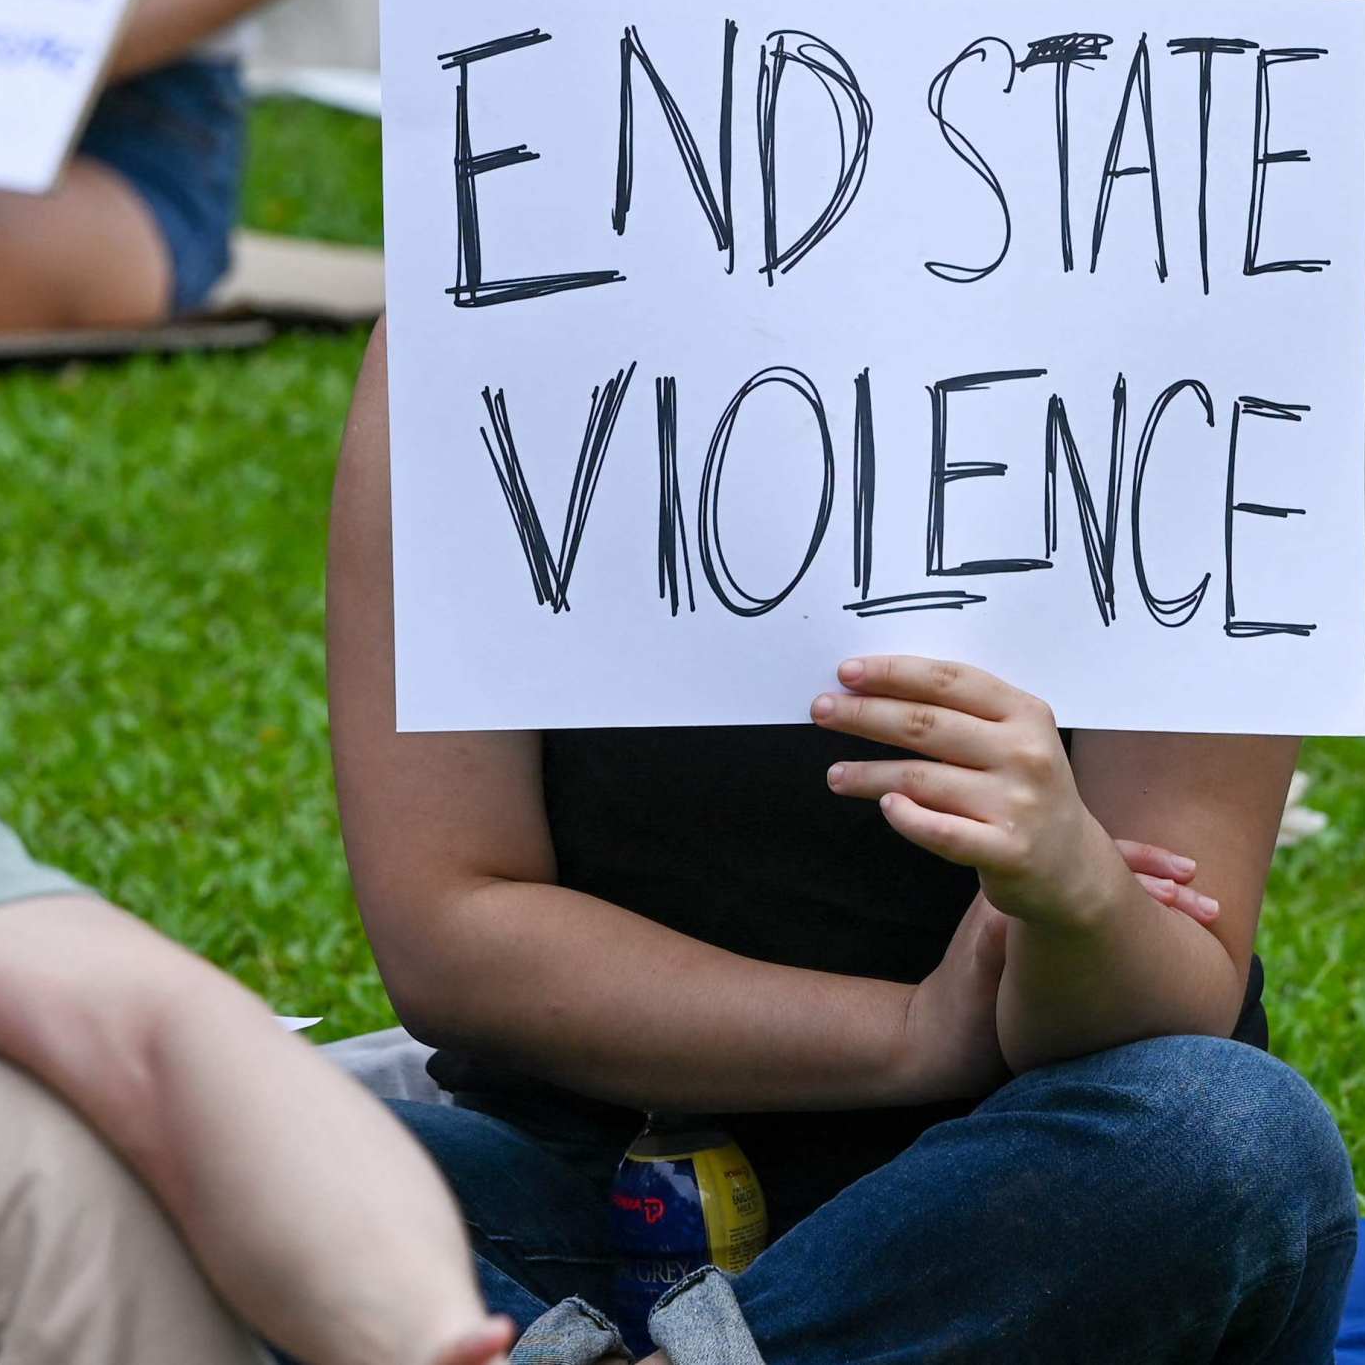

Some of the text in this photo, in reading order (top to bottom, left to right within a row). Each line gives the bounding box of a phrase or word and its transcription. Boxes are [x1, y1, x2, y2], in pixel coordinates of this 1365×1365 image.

[437, 19, 1331, 308] END STATE
[480, 361, 1316, 637] VIOLENCE
